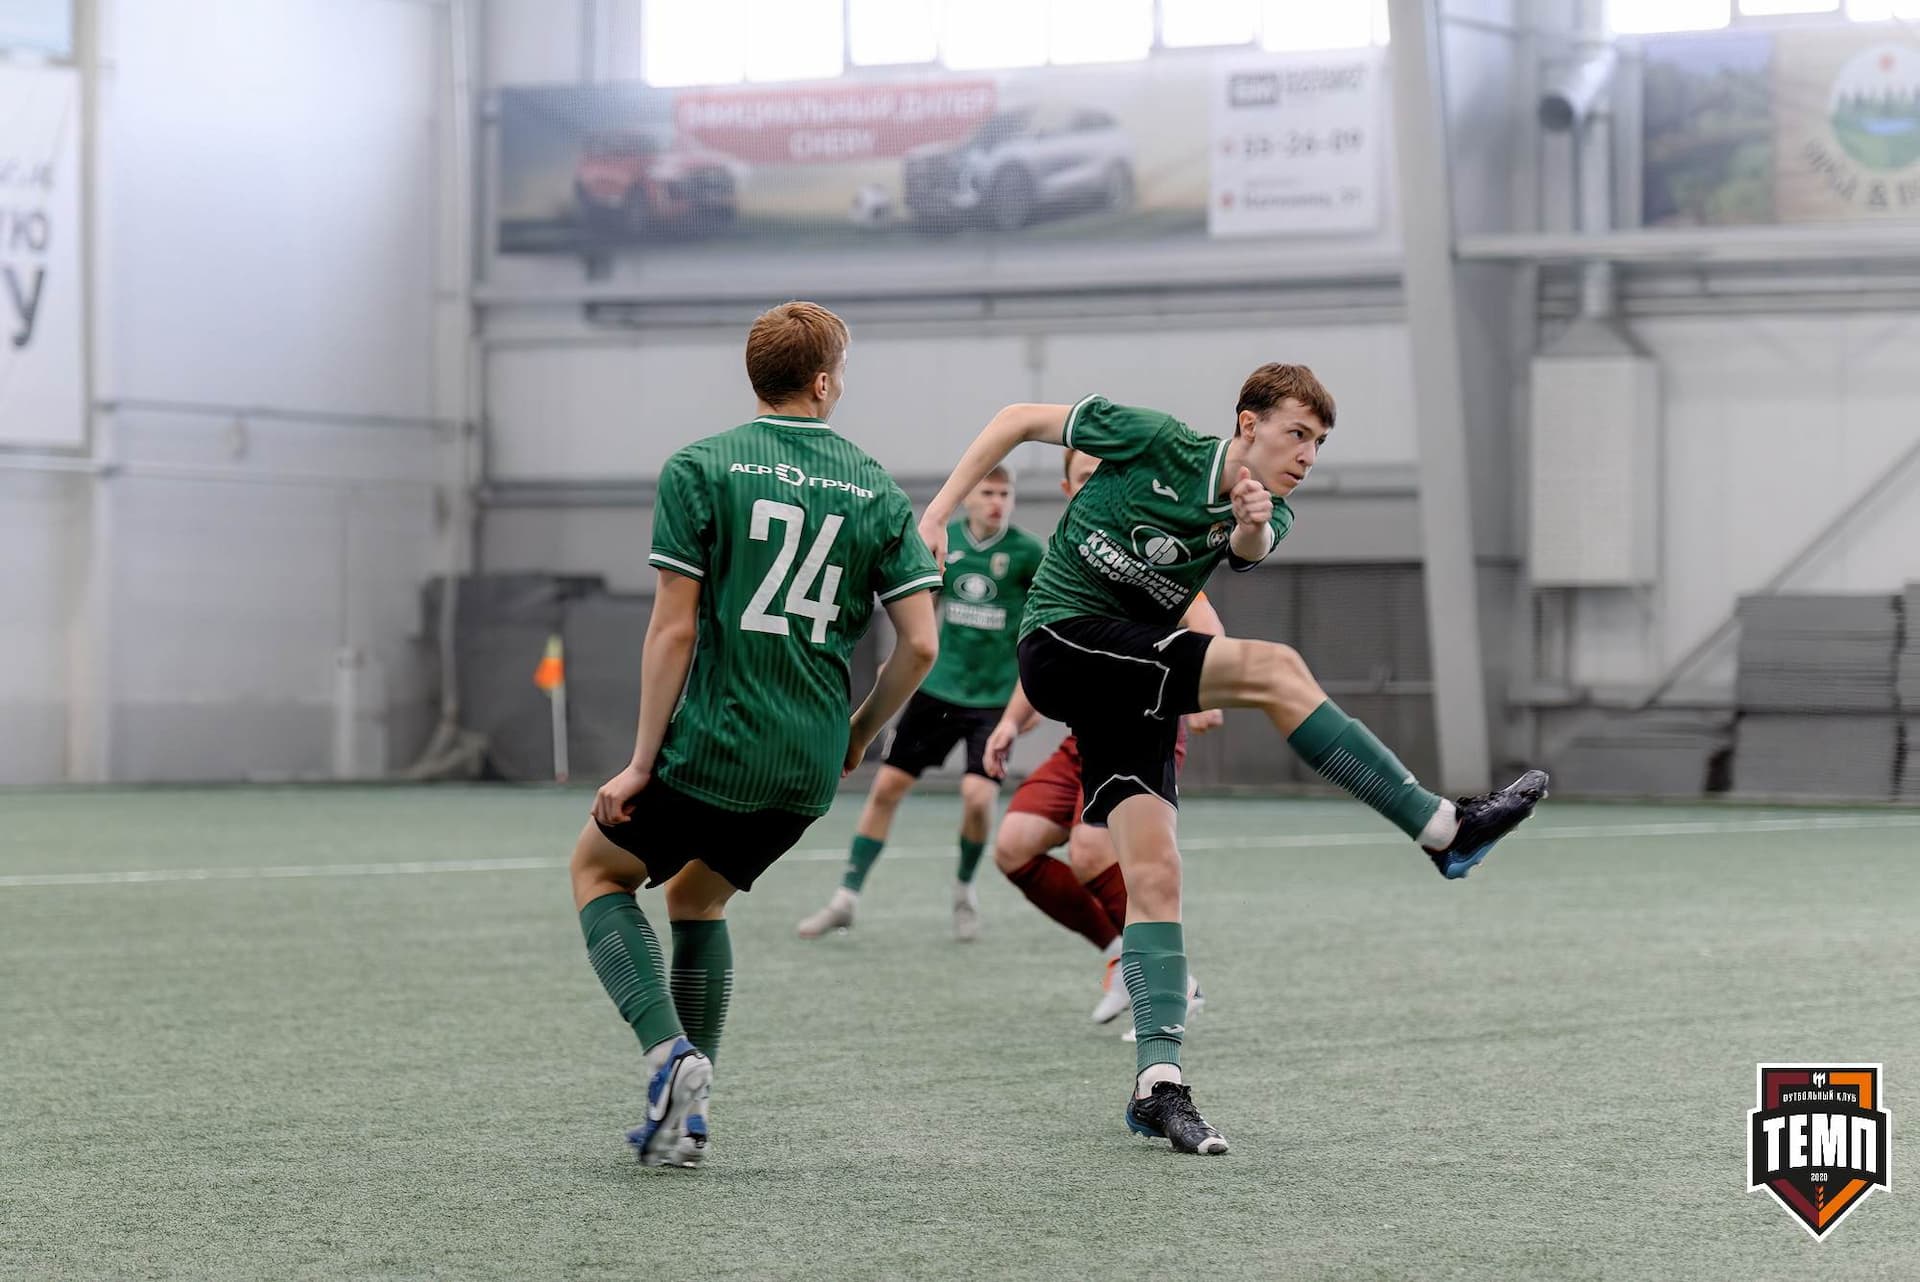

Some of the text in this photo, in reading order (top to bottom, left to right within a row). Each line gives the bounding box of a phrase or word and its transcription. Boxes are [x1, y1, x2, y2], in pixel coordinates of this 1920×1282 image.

[730, 463, 874, 498] АСР ГРУПП
[740, 498, 845, 644] 24
[1086, 531, 1185, 605] КУЗНЕЦКИЕ
